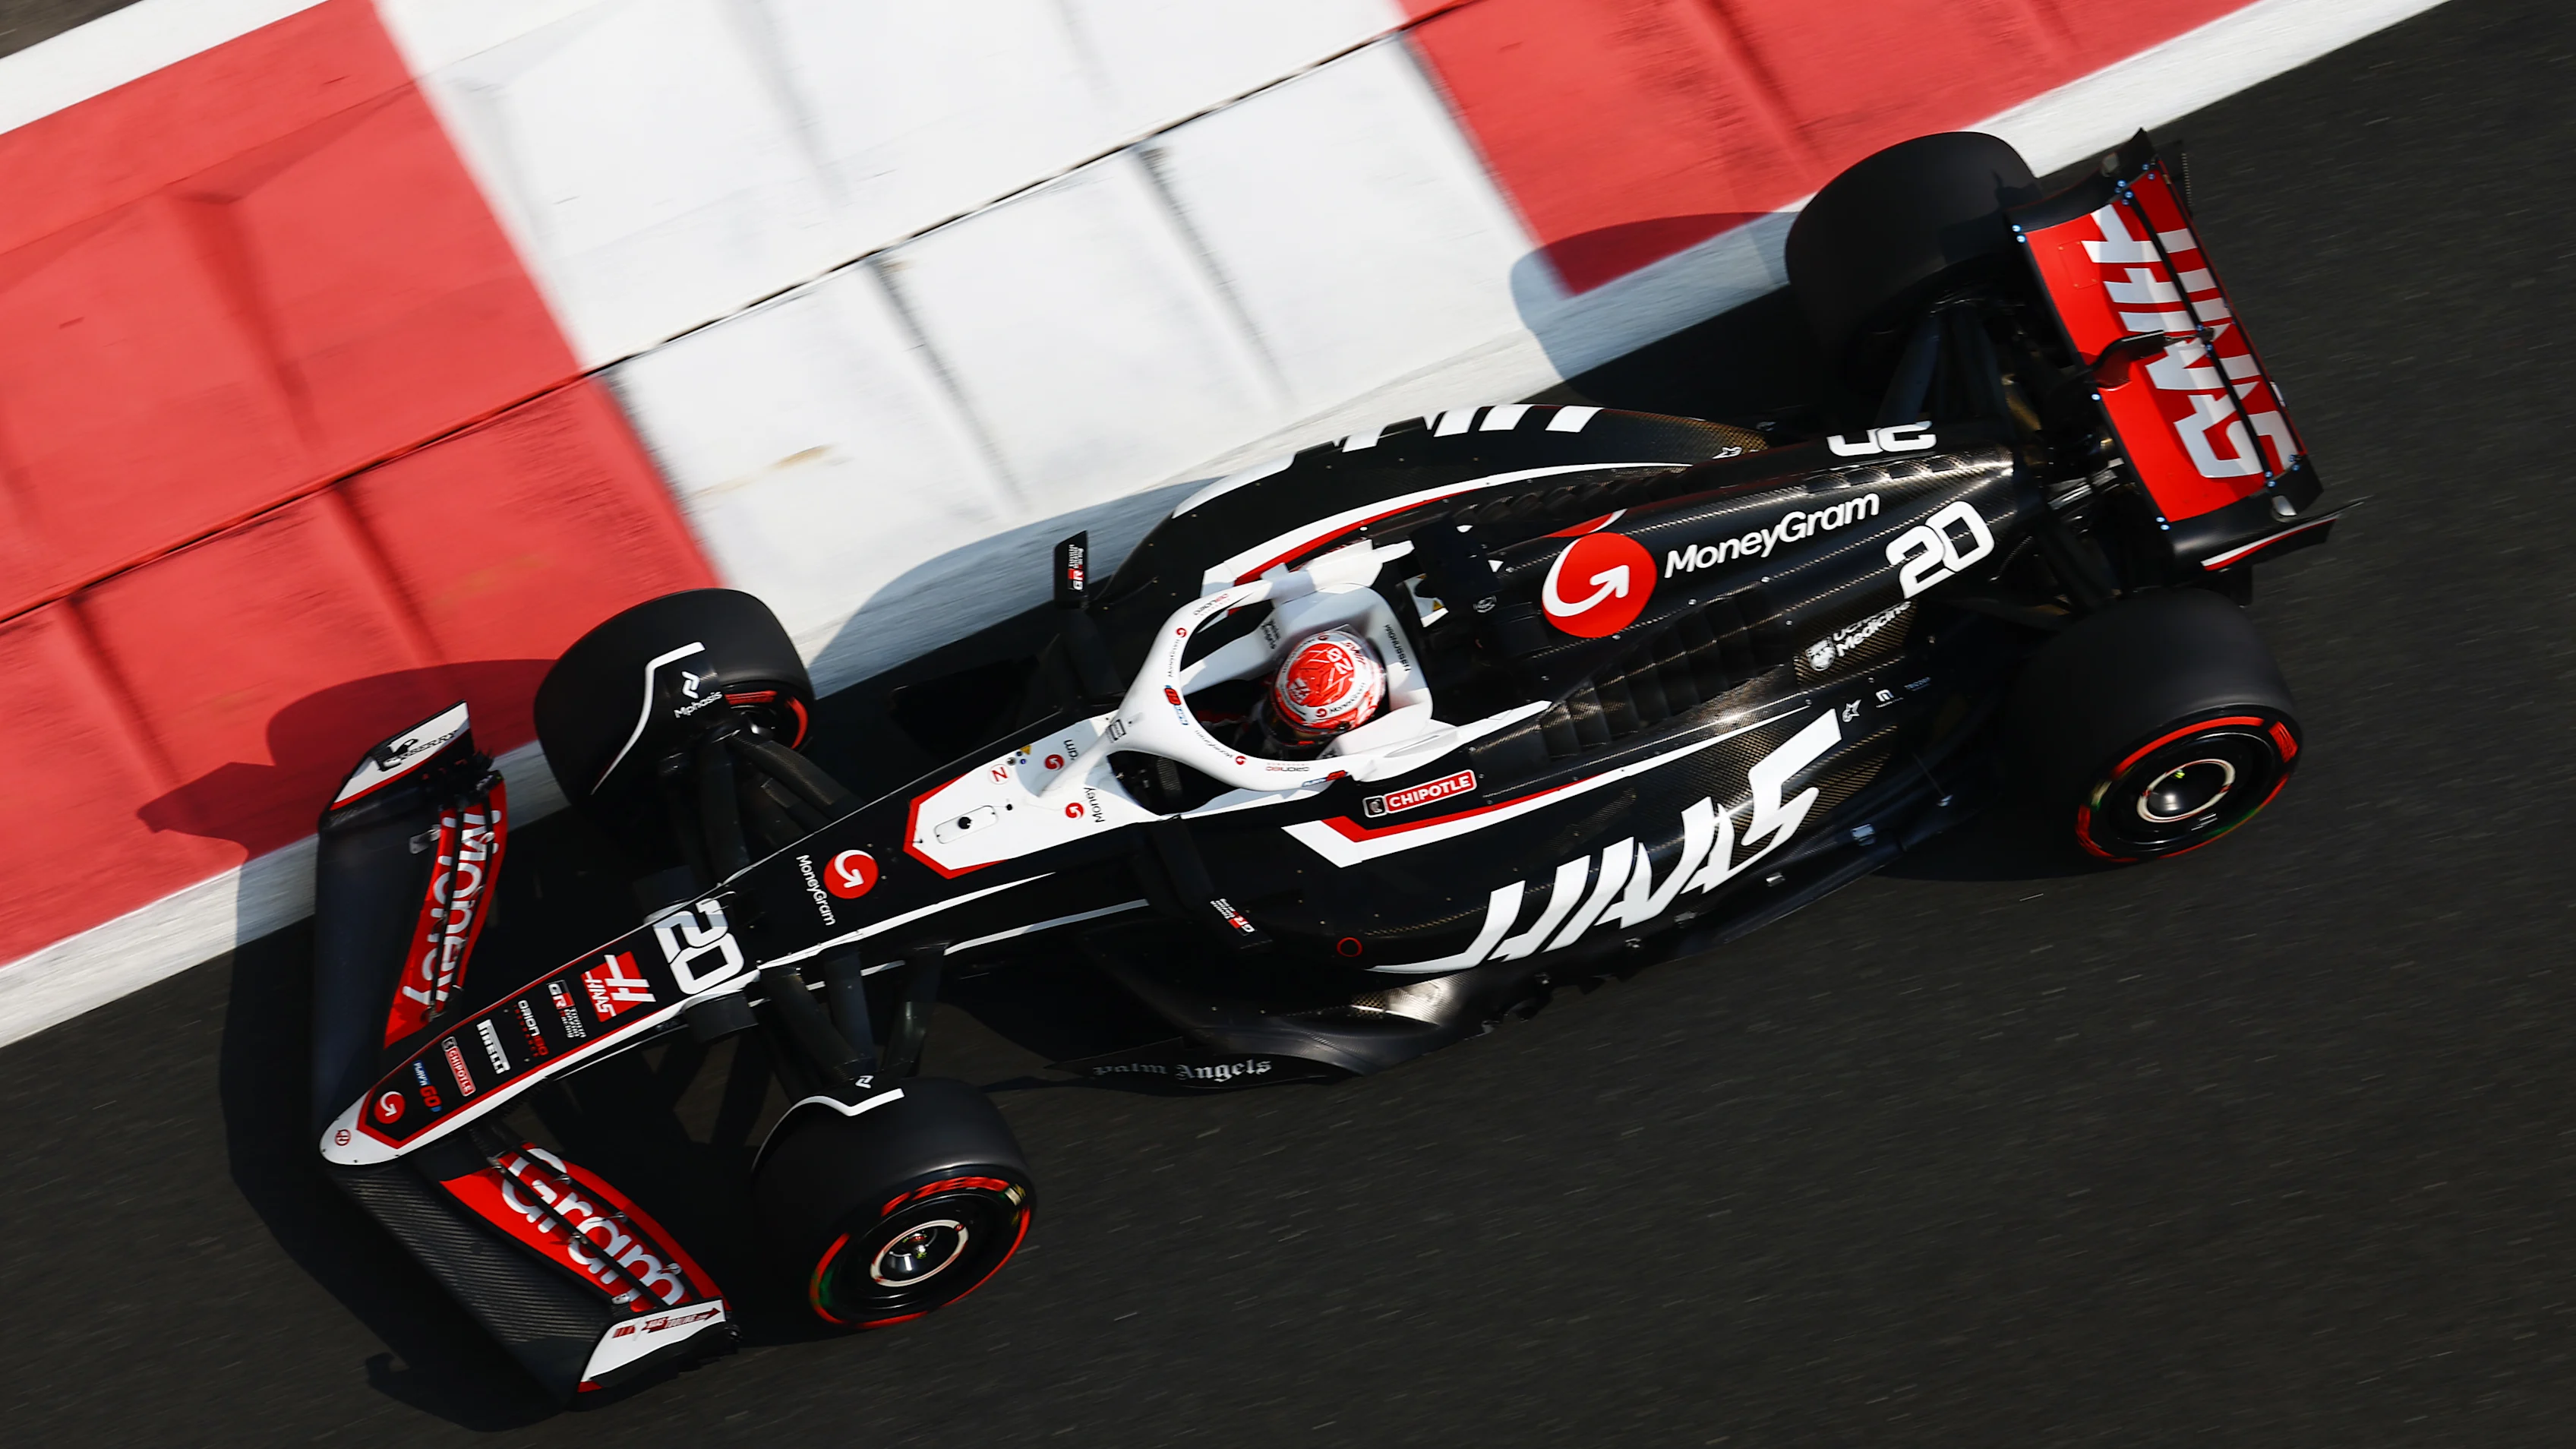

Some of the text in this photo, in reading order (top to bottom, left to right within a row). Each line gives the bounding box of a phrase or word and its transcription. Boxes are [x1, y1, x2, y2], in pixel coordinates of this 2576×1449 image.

[2081, 204, 2298, 478] HAAS
[1664, 493, 1880, 578] MoneyGram
[1886, 501, 1994, 599] 20
[1836, 601, 1911, 657] Medicine
[1327, 648, 1353, 674] 20
[674, 691, 722, 718] Mphasis
[1084, 787, 1106, 822] Money
[1389, 775, 1471, 807] CHIPOTLE
[1367, 709, 1842, 974] HAAS
[402, 810, 501, 1005] Money
[796, 854, 835, 926] MoneyGram
[652, 898, 745, 995] 20
[548, 983, 567, 1009] GR
[584, 971, 617, 1017] HAAS
[476, 1018, 511, 1075] PIRELLI
[570, 1006, 587, 1038] TOYOTA
[420, 1085, 441, 1107] GO
[448, 1049, 472, 1093] CHIPOTLE
[1175, 1059, 1273, 1082] Angels
[501, 1148, 686, 1307] Gram
